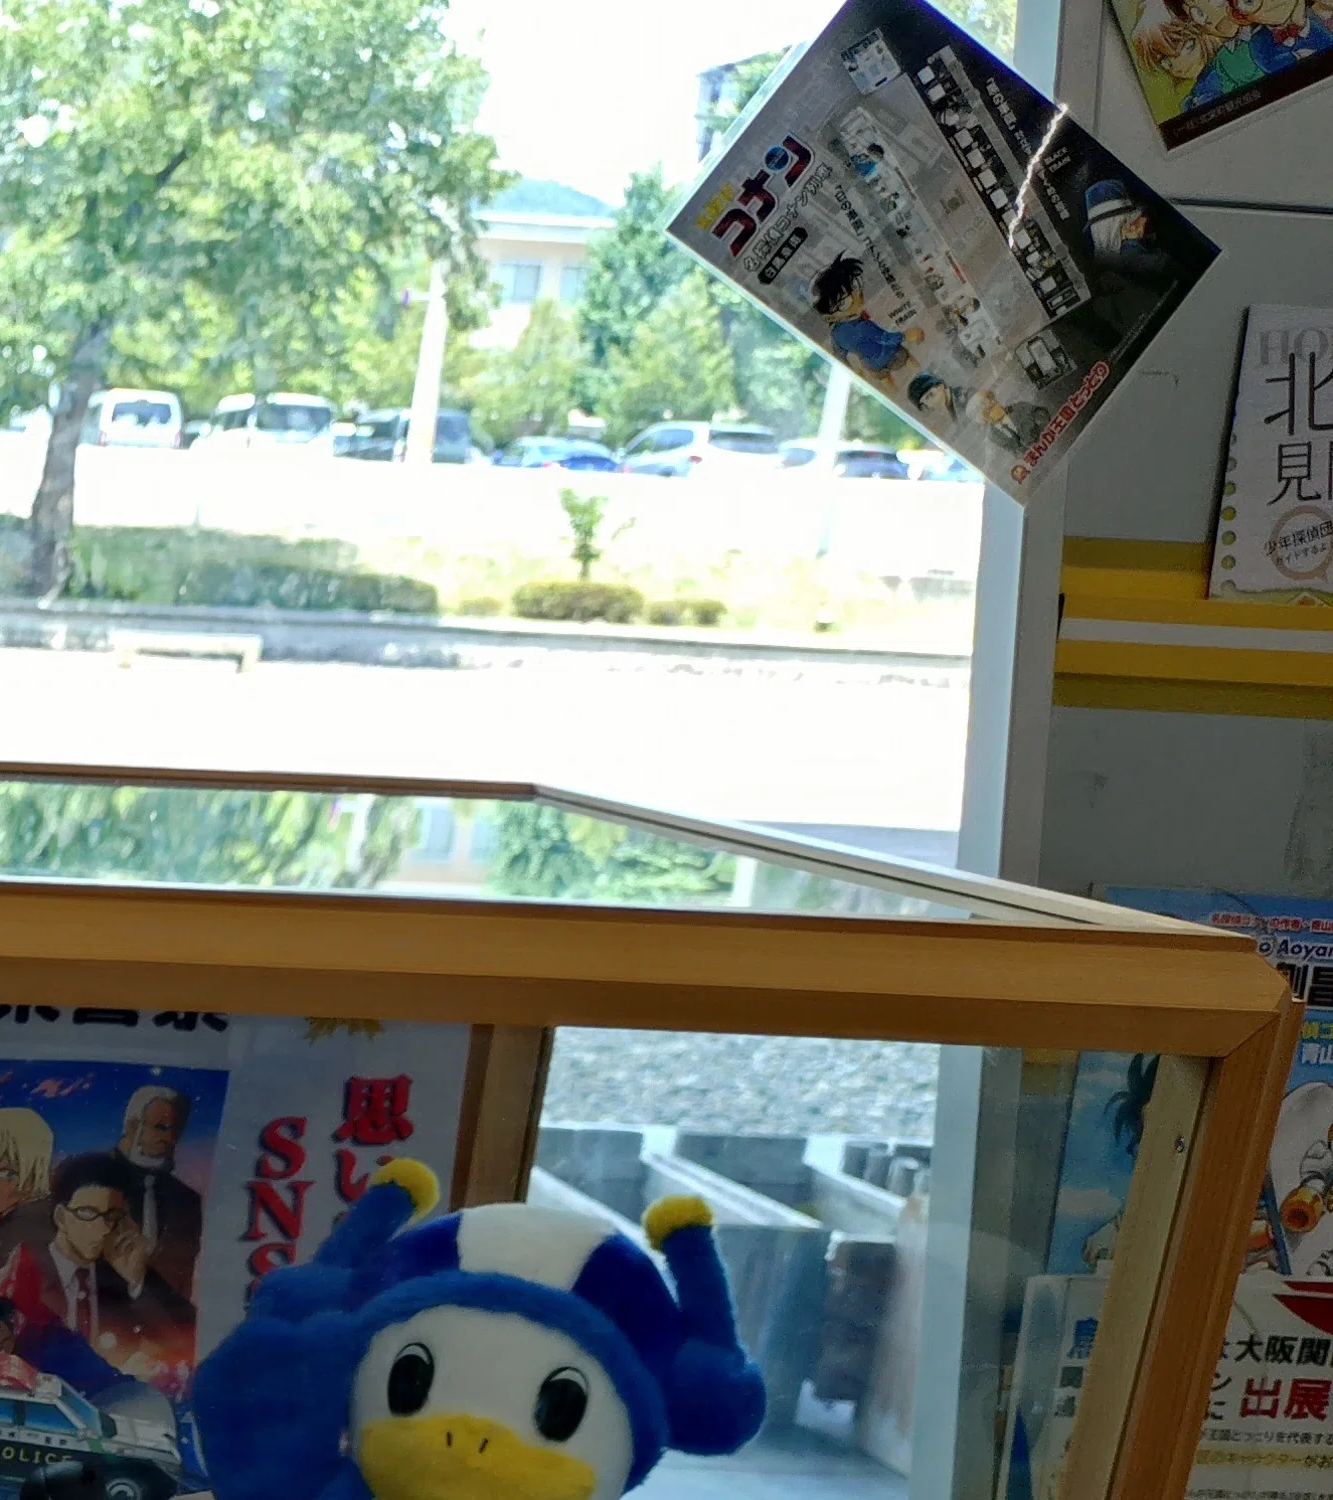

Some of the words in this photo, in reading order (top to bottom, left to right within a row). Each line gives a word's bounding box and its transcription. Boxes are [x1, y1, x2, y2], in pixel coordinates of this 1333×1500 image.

[709, 132, 814, 257] コナン
[1259, 327, 1333, 365] HO
[1023, 360, 1110, 468] まんが王国とっとり
[1266, 440, 1333, 506] 見
[332, 1073, 414, 1205] 思い
[1234, 1333, 1333, 1366] 大阪関
[1239, 1376, 1332, 1421] 出展
